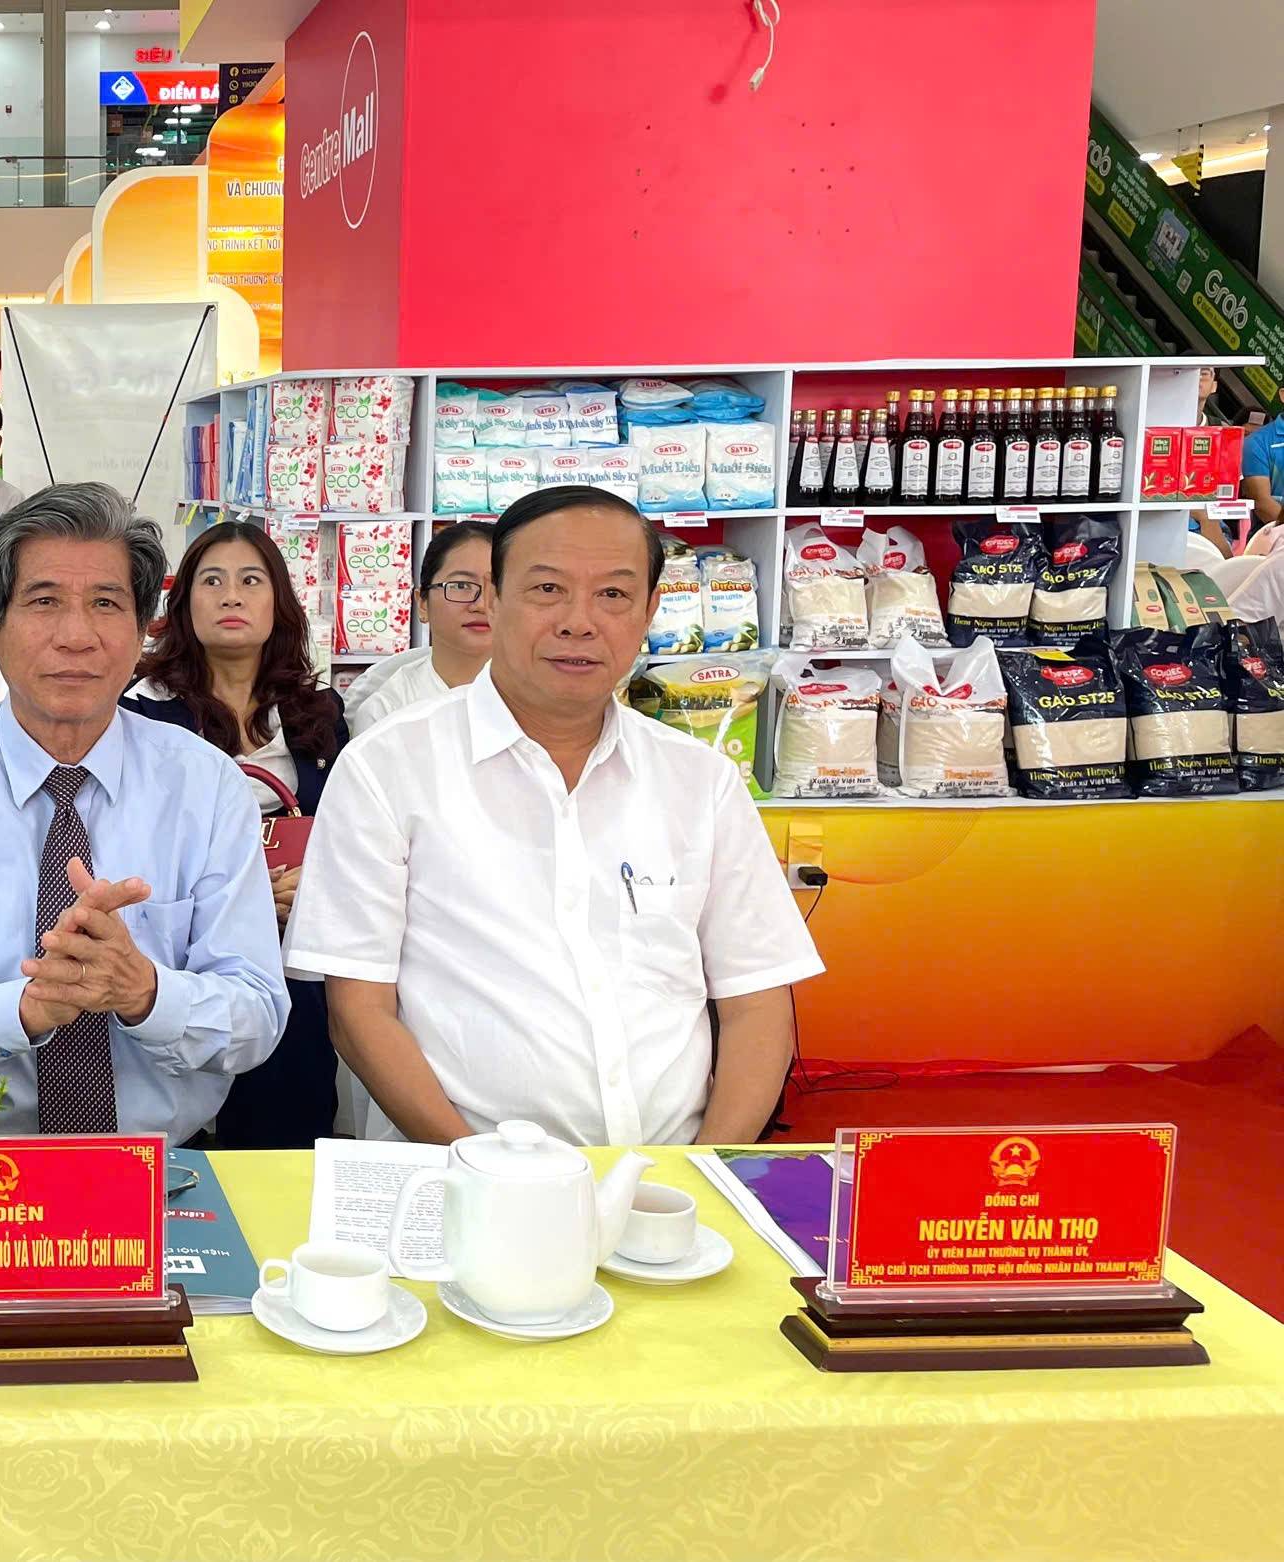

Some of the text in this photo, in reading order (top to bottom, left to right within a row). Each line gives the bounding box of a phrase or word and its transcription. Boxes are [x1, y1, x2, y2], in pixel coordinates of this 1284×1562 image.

[159, 80, 197, 101] ĐIỂM
[300, 91, 374, 200] Centre Mall
[1087, 138, 1112, 177] rab
[227, 179, 241, 197] VÀ
[1204, 269, 1249, 330] Grab
[274, 406, 302, 420] eco
[336, 404, 369, 419] eco
[641, 460, 673, 475] Muối
[710, 460, 742, 474] Muối
[270, 472, 298, 487] eco
[326, 473, 361, 489] eco
[279, 546, 299, 560] co
[348, 554, 390, 569] eco
[998, 563, 1023, 574] ST25
[1067, 567, 1100, 582] ST25
[710, 580, 752, 593] Đường
[346, 619, 388, 633] eco
[697, 669, 734, 681] SATRA
[1038, 691, 1115, 709] GẠO ST25
[984, 1191, 1040, 1208] ĐỒNG CHÍ
[919, 1211, 1099, 1244] NGUYỄN VĂN THỌ
[13, 1233, 29, 1269] VÀ
[32, 1234, 55, 1268] VỪA
[56, 1228, 90, 1267] TP.HỒ
[91, 1232, 111, 1267] CHÍ
[113, 1238, 145, 1267] MINH
[926, 1244, 941, 1259] ỦY
[941, 1244, 964, 1259] VIÊN
[966, 1247, 986, 1258] BAN
[988, 1244, 1025, 1259] THƯỜNG
[1027, 1247, 1041, 1260] VỤ
[1042, 1243, 1074, 1258] THÀNH
[865, 1259, 1148, 1277] PHÓ CHỦ TỊCH THƯỜNG TRỰC HỘI ĐỒNG NHÂN DÂN THÀNH PHỐ
